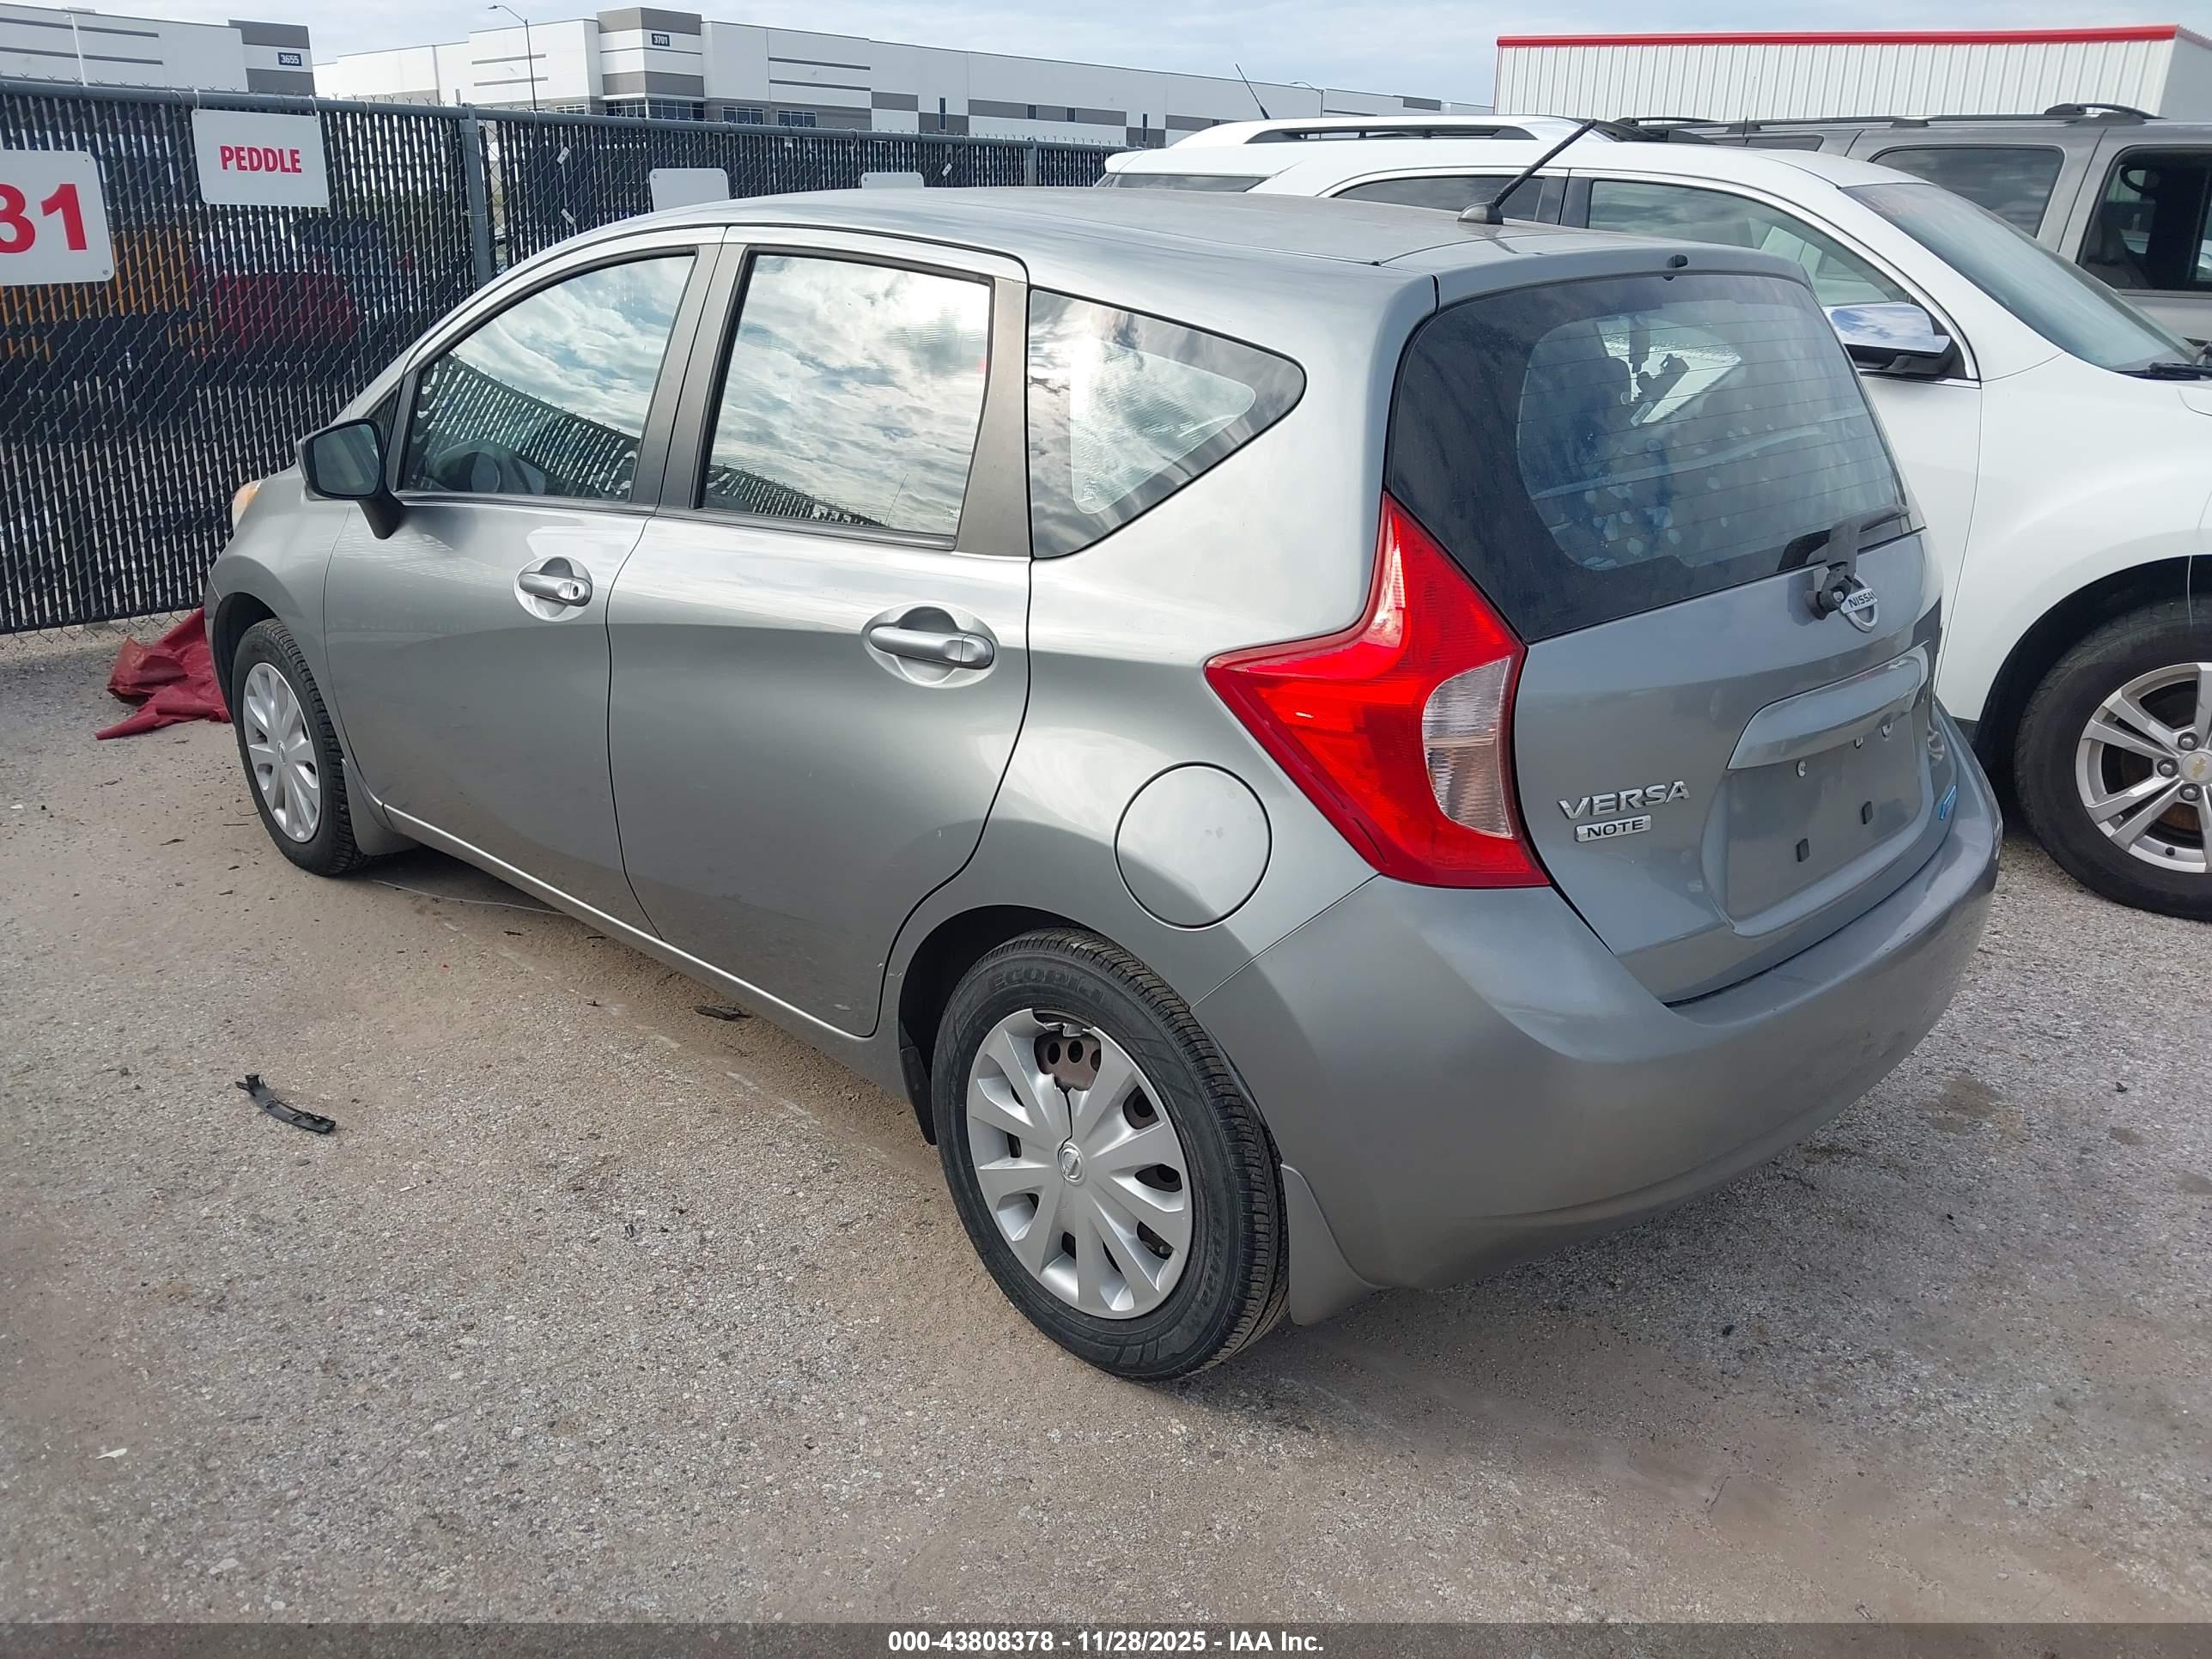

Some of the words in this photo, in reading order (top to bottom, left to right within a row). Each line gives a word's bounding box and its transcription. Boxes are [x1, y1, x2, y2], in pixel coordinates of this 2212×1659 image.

[653, 35, 668, 45] 3701
[280, 54, 300, 64] 3655
[220, 146, 302, 173] PEDDLE
[1558, 780, 1690, 820] VERSA
[1587, 818, 1644, 838] NOTE
